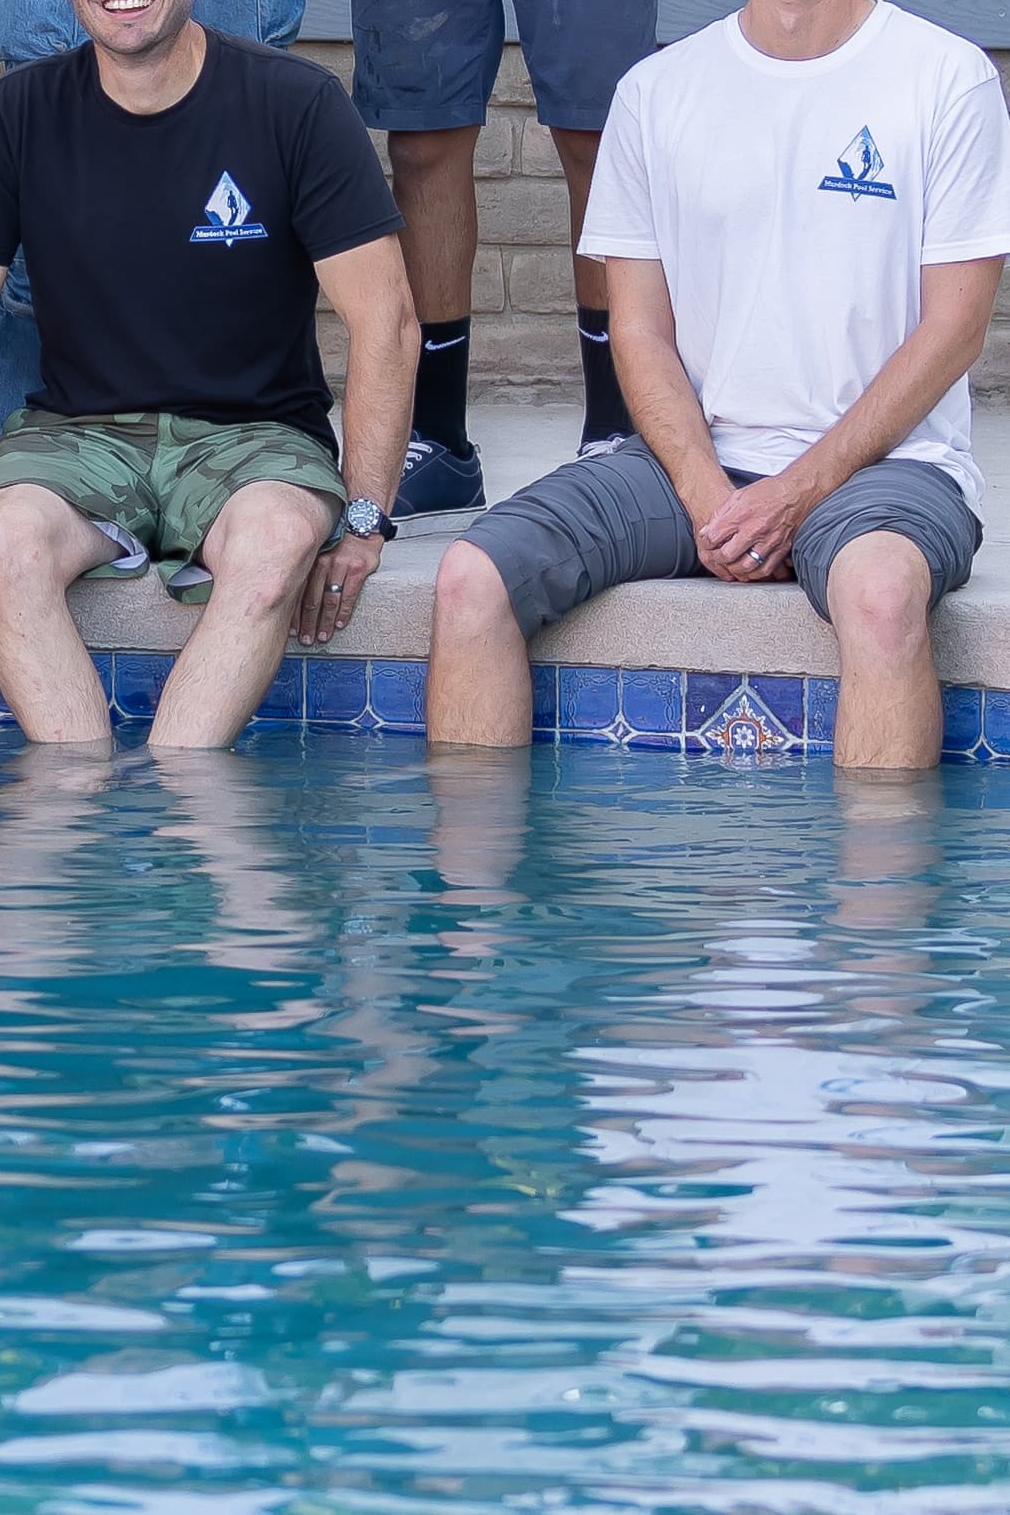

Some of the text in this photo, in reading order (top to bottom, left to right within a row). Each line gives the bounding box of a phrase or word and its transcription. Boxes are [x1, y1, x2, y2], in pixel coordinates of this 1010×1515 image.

[853, 183, 868, 192] Pool
[869, 186, 893, 195] Service
[196, 230, 225, 238] Murdock
